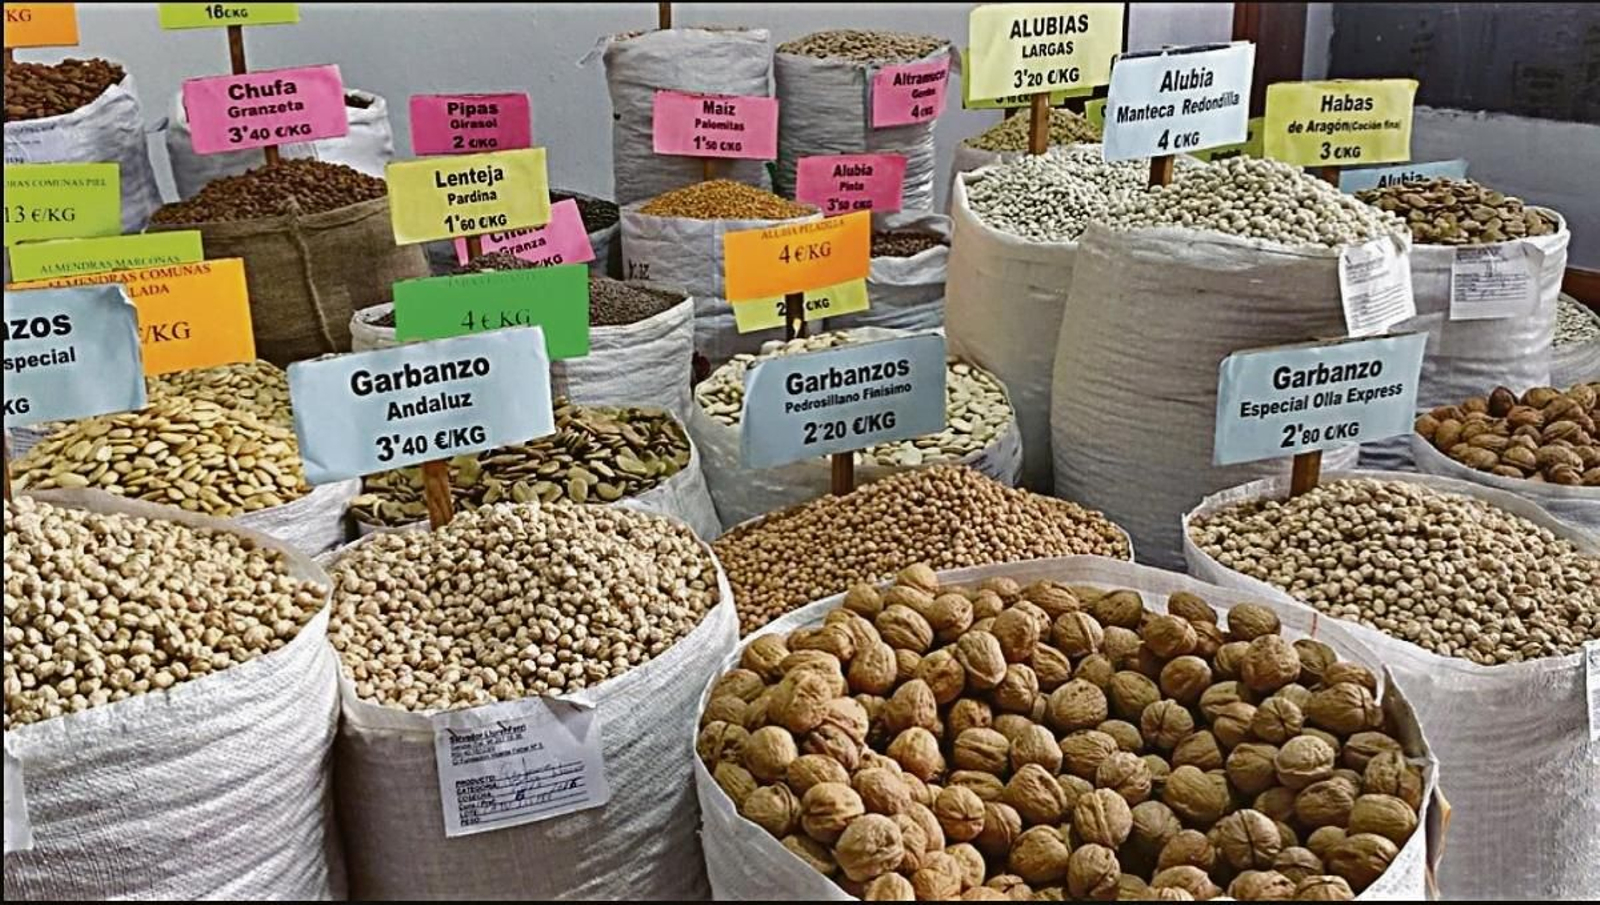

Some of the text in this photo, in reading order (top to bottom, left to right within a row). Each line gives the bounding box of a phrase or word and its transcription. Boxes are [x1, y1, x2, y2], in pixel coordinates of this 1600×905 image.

[1009, 14, 1089, 39] ALUBIAS
[1022, 41, 1074, 58] LARGAS
[1159, 67, 1214, 93] Alubia
[228, 80, 297, 100] Chufa
[228, 100, 304, 118] Granzeta
[447, 102, 498, 118] Pipas
[911, 105, 919, 118] 4
[1116, 105, 1175, 124] Manteca
[1182, 92, 1240, 115] Redondilla
[1320, 94, 1374, 113] Habas
[275, 124, 312, 138] €/KG
[450, 118, 497, 129] Girasol
[695, 118, 745, 131] Palomitas
[1287, 121, 1303, 133] de
[453, 135, 464, 148] 2
[1157, 129, 1170, 150] 4
[1320, 141, 1331, 160] 3
[435, 165, 504, 188] Lenteja
[833, 163, 873, 178] Alubia
[447, 190, 497, 206] Pardina
[31, 207, 76, 222] €/KG
[499, 237, 547, 256] Granza
[778, 241, 832, 264] 4 €/KG
[140, 263, 212, 281] COMUNAS
[128, 284, 170, 298] LADA
[461, 310, 474, 330] 4
[4, 346, 76, 373] special
[350, 356, 491, 396] Garbanzo
[785, 358, 910, 395] Garbanzos
[1273, 359, 1383, 390] Garbanzo
[386, 391, 473, 421] Andaluz
[784, 393, 860, 414] Pedrosillano
[1240, 382, 1403, 419] Especial Olla Express
[852, 411, 896, 435] €/KG
[433, 425, 486, 450] €/KG
